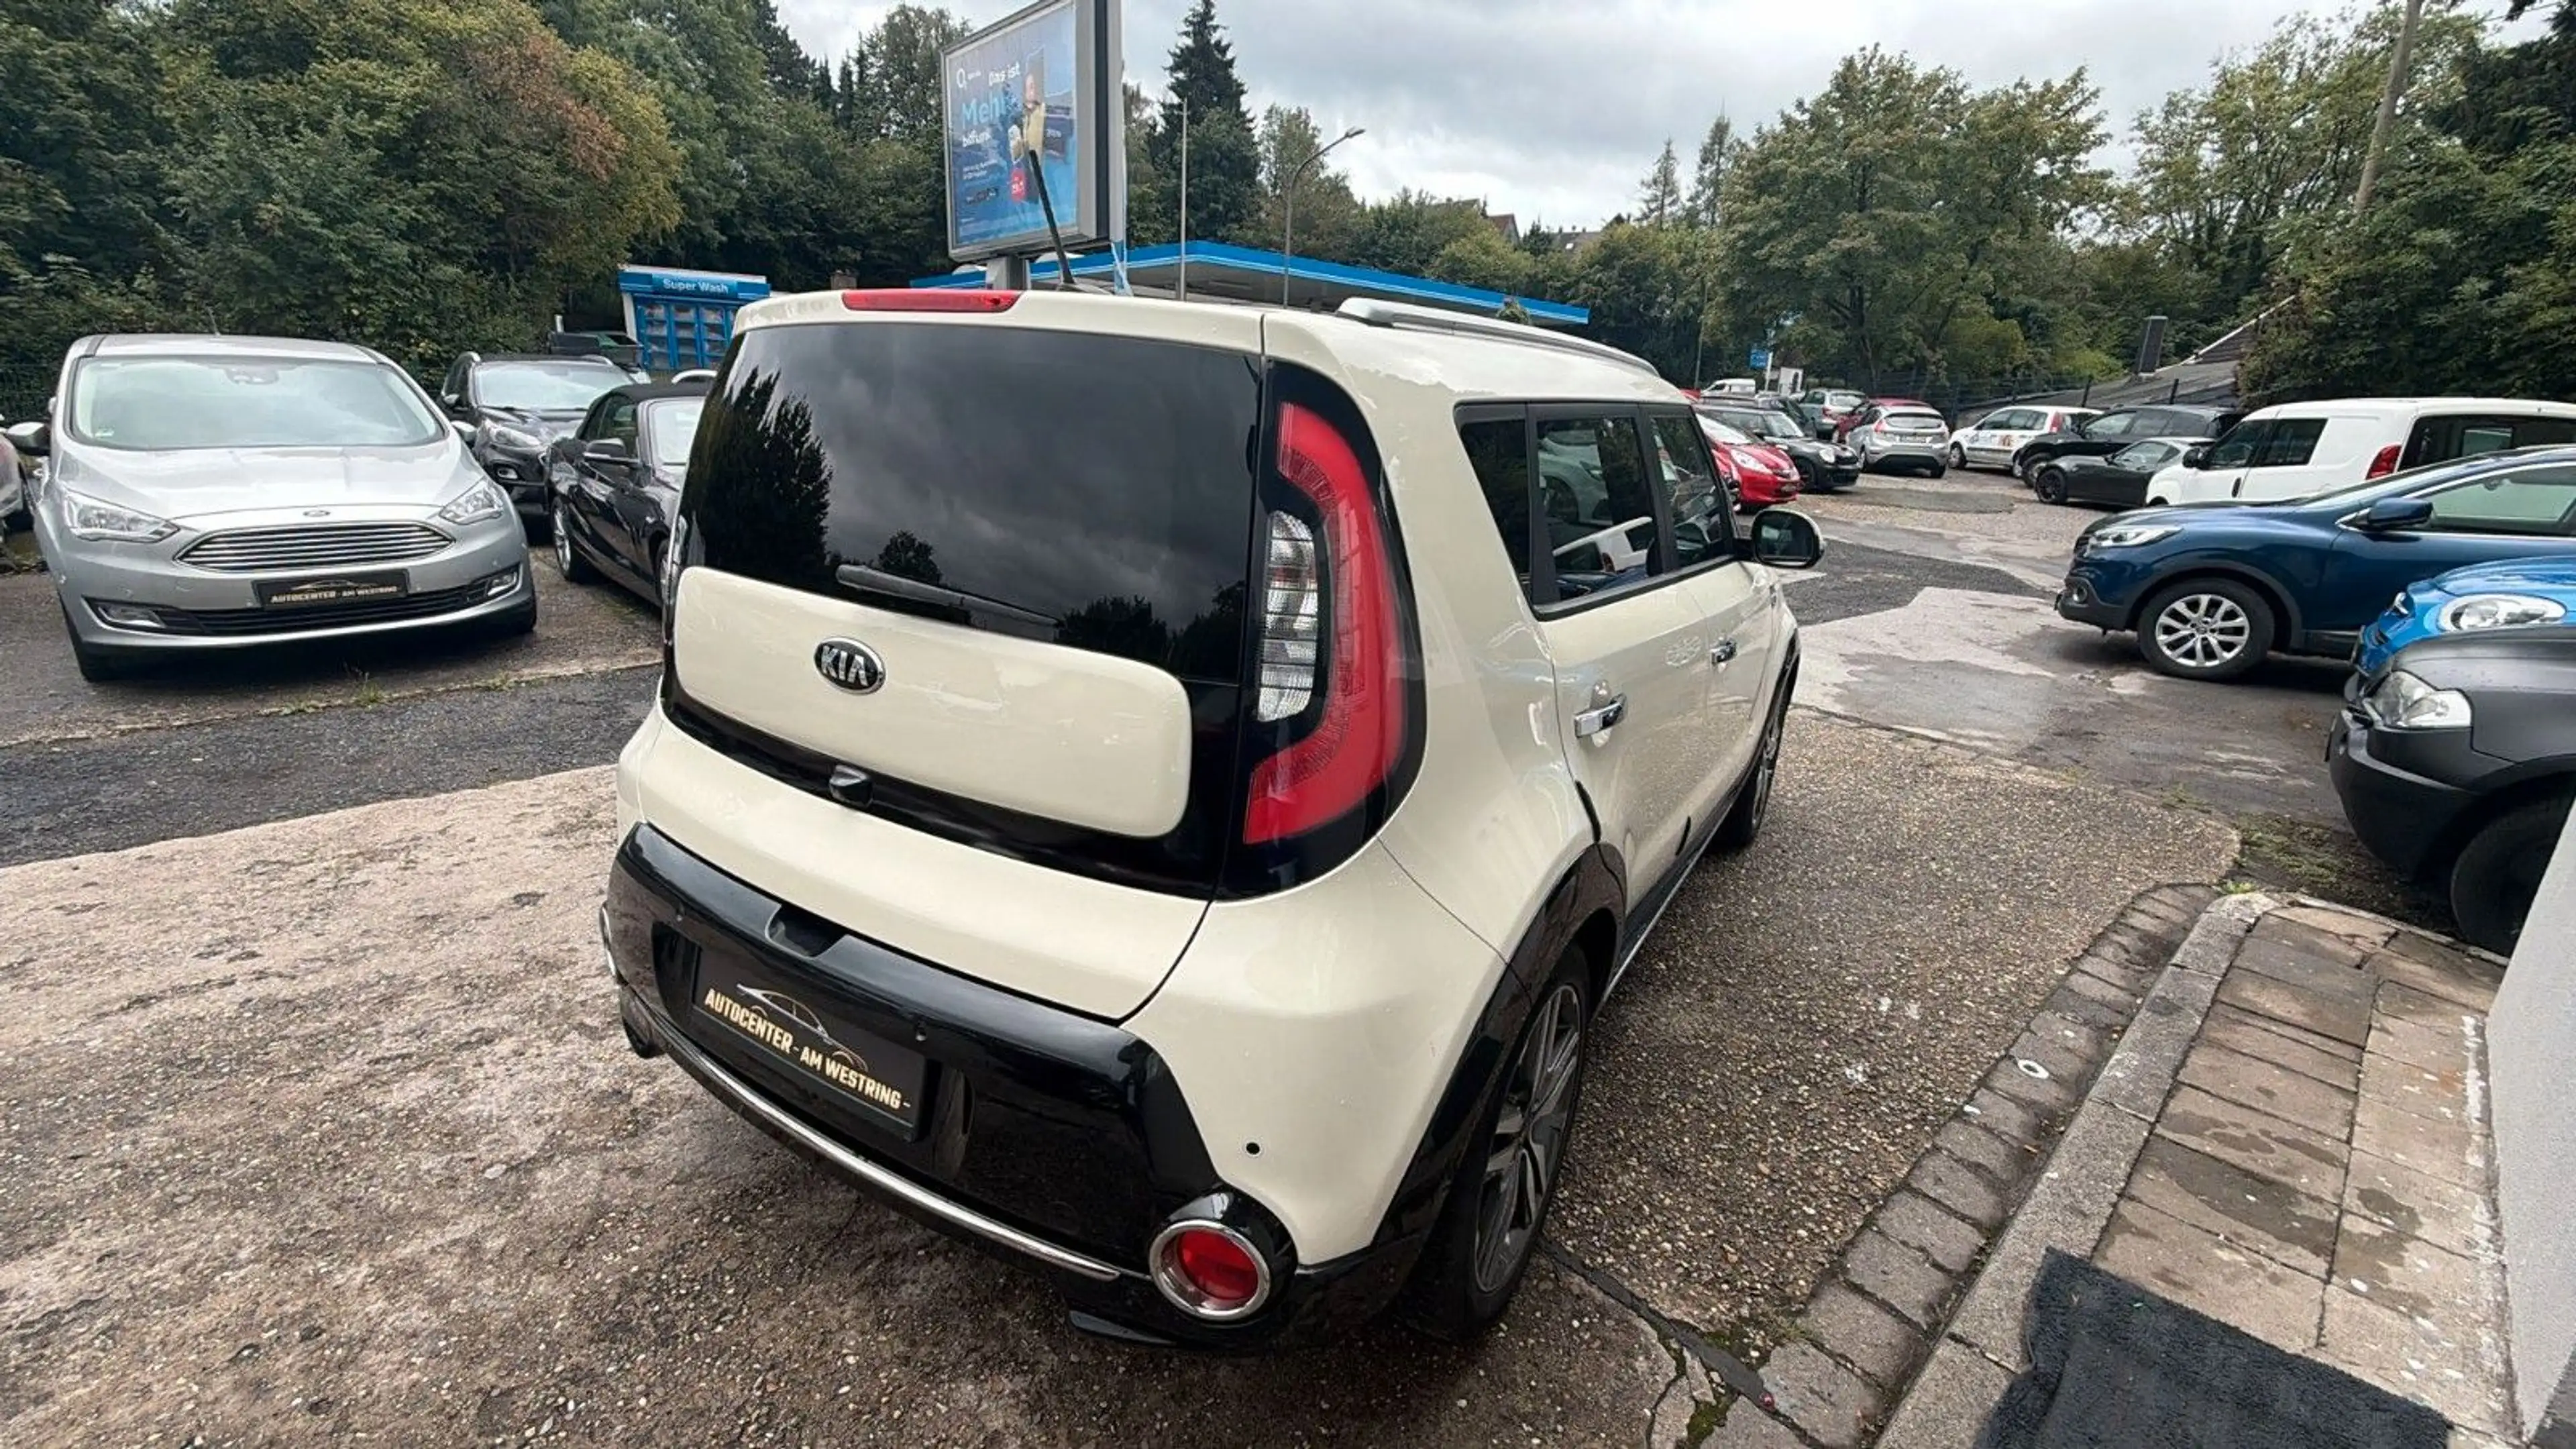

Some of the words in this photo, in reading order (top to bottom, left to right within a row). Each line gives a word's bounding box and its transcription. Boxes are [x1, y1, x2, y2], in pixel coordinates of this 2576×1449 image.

[1007, 61, 1020, 79] ist
[663, 278, 696, 292] Super
[698, 281, 729, 294] Wash
[270, 590, 336, 603] AUTOCENTER
[341, 588, 356, 597] AM
[821, 645, 869, 686] KIA
[704, 988, 794, 1054] AUTOCENTER
[800, 1046, 823, 1071] AM
[825, 1057, 902, 1110] WESTRING
